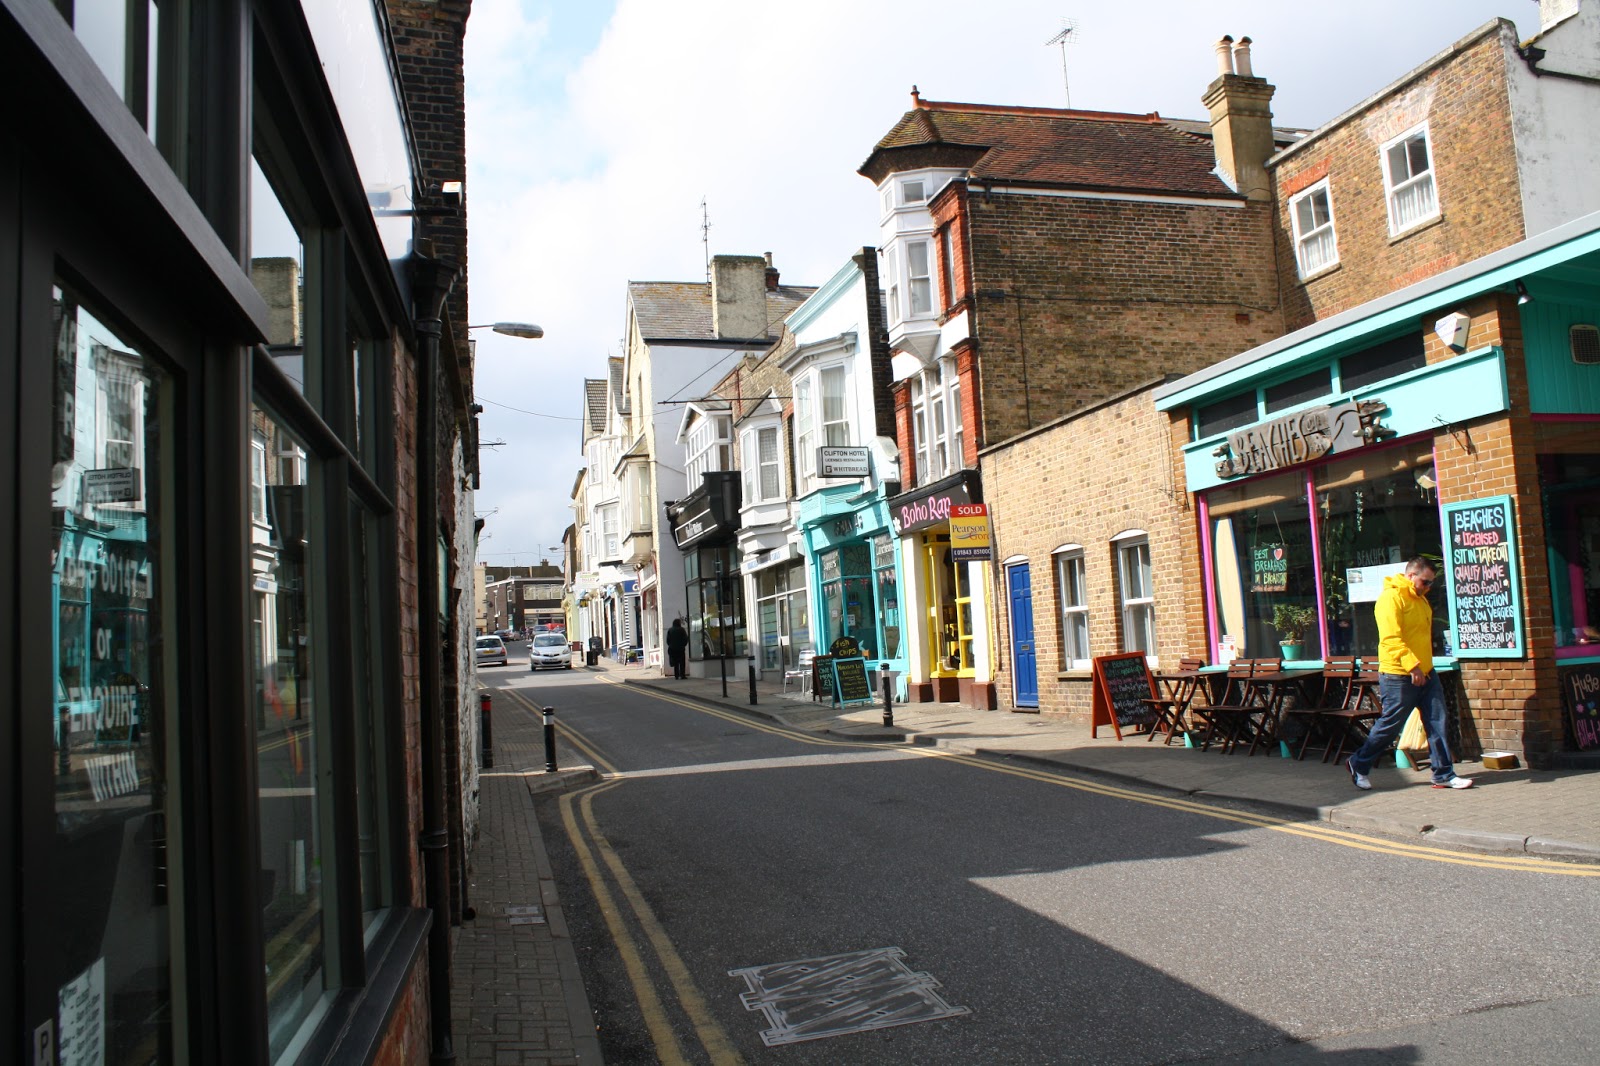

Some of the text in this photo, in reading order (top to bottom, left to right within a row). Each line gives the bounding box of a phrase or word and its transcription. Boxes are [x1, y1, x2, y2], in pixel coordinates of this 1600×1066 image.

[1236, 414, 1310, 474] BEACHES
[901, 502, 928, 529] Boho
[958, 506, 982, 515] SOLD
[1454, 506, 1504, 532] BEACHES
[952, 524, 986, 533] Pearson
[1462, 531, 1499, 546] LICENSED
[1254, 548, 1269, 560] BEST
[1454, 548, 1467, 565] SIT
[1454, 564, 1505, 582] QUALITY HOME
[1455, 582, 1480, 595] COOKED
[1474, 591, 1509, 608] SELECTION
[1487, 605, 1514, 621] VEGGIES
[1458, 621, 1506, 633] SERVING THE BEST
[1571, 673, 1600, 701] Huge
[68, 685, 139, 733] ENQUIRE
[84, 750, 140, 803] WITHIN
